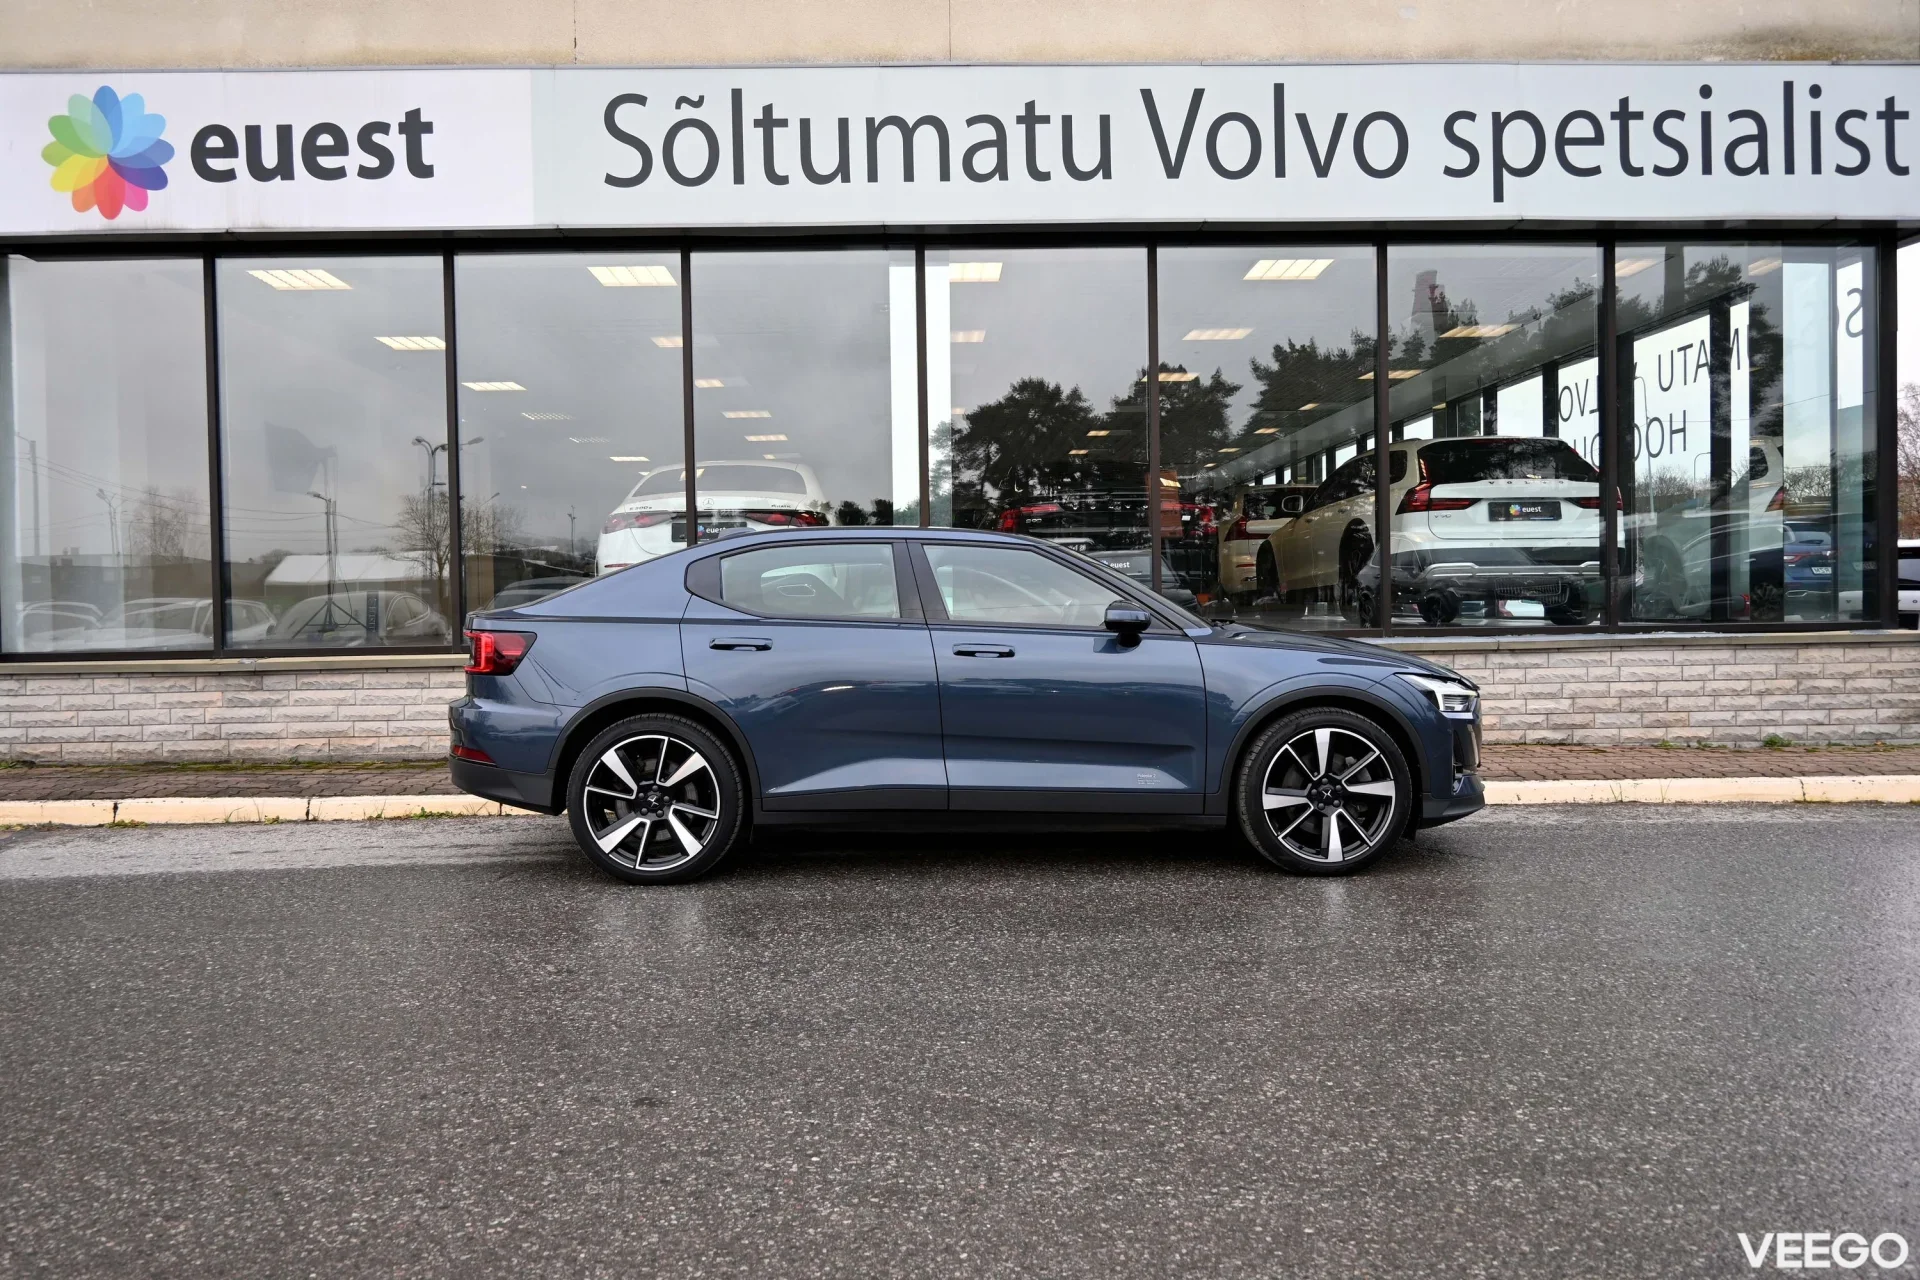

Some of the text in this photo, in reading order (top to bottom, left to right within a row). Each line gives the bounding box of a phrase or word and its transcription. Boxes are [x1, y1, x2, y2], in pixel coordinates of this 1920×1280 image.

[190, 107, 435, 183] euest
[604, 81, 1911, 203] Sõltumatu Volvo spetsialist
[1109, 560, 1131, 569] euest
